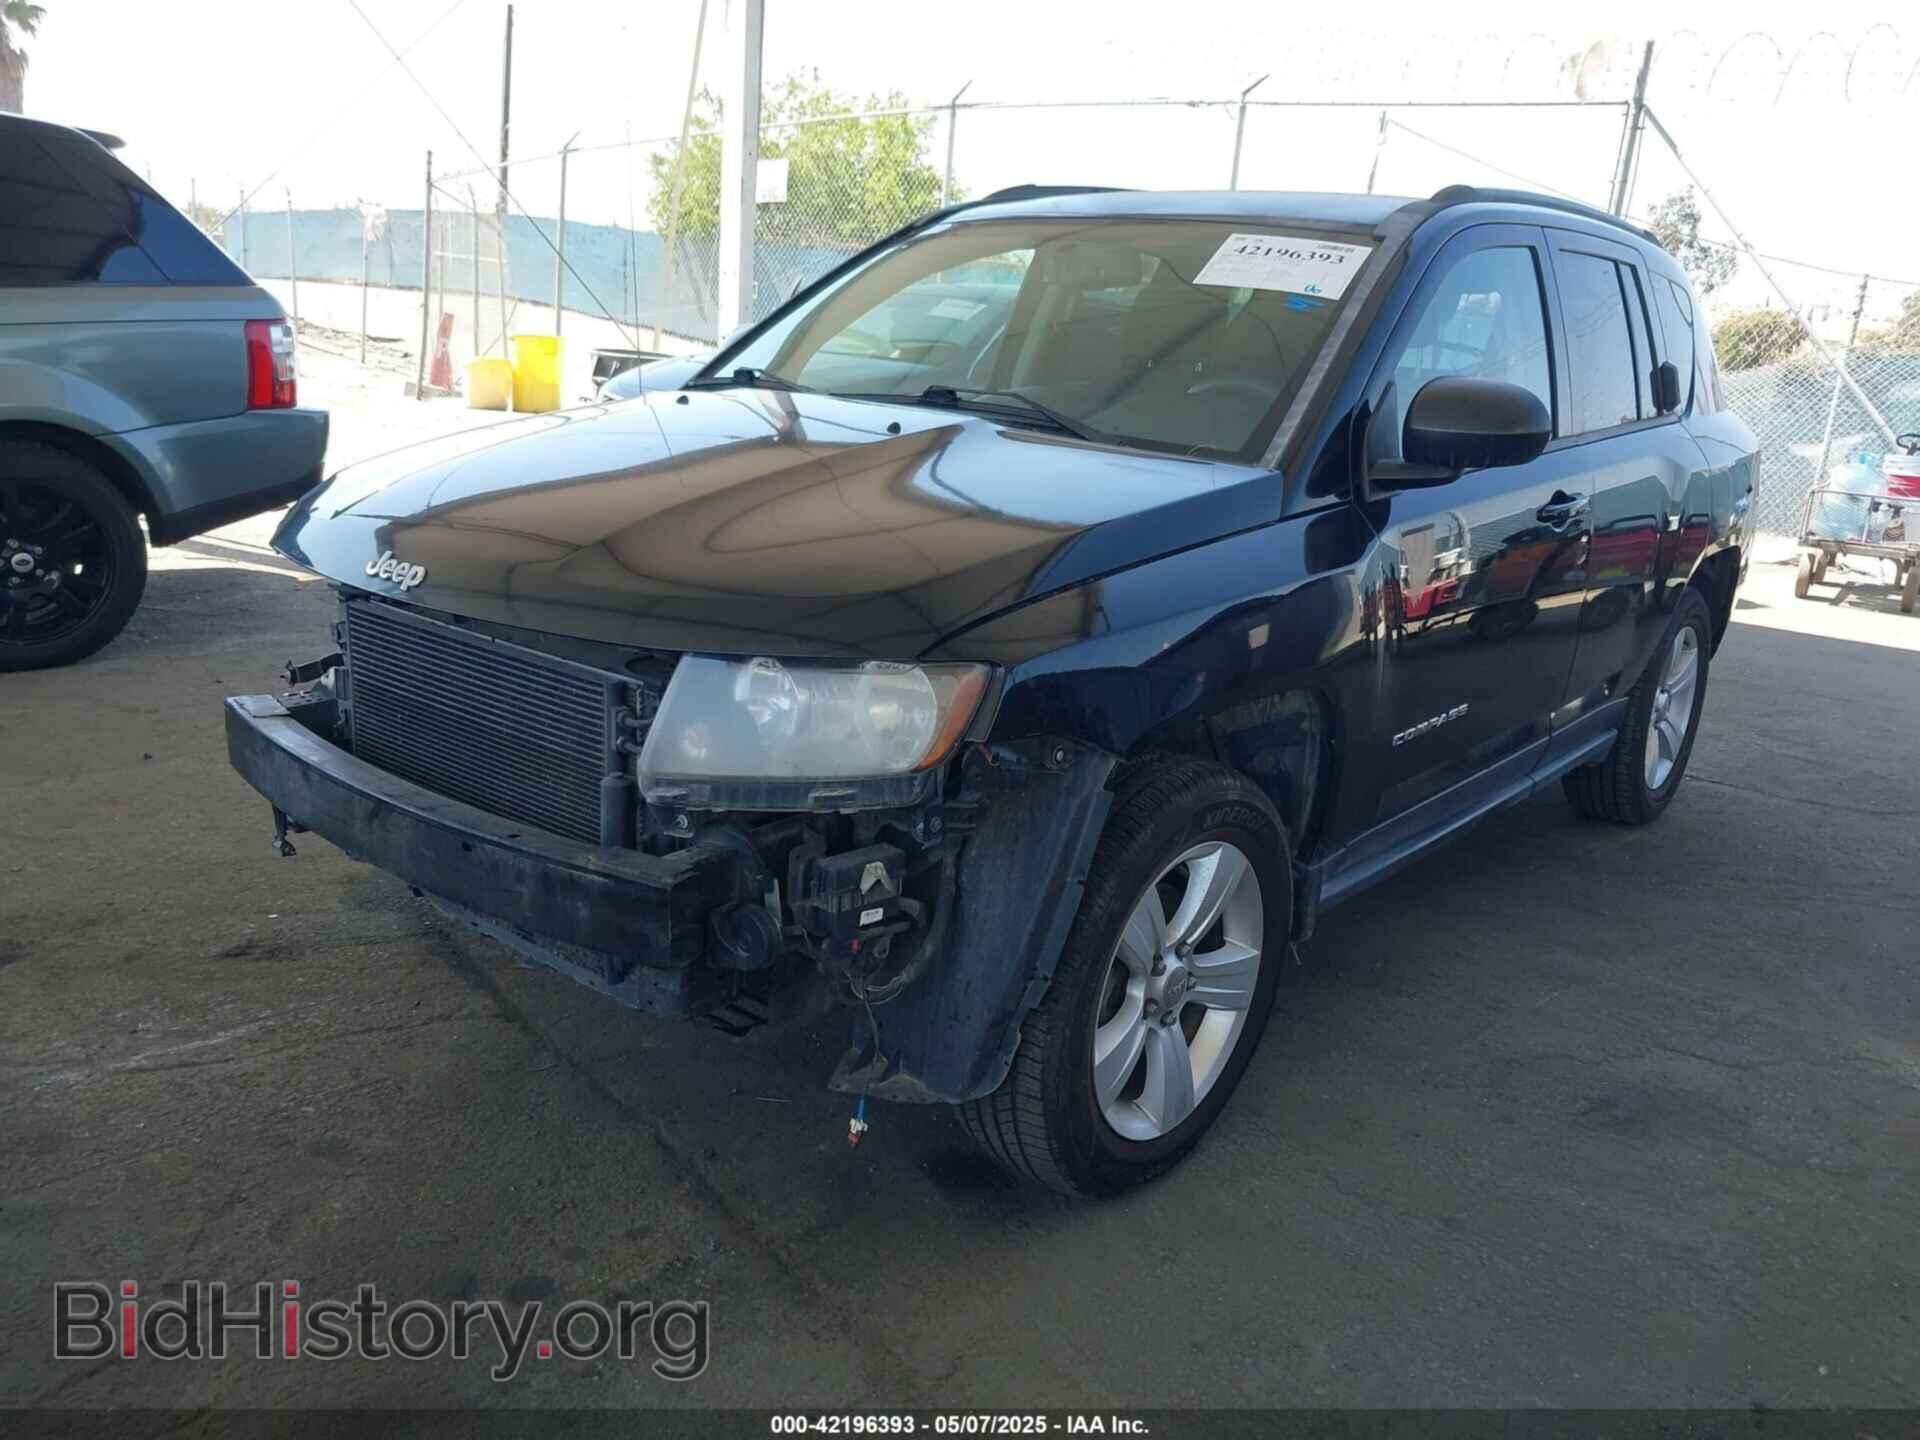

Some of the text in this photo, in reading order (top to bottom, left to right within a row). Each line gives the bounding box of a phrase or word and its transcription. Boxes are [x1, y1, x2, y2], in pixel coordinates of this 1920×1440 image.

[1233, 244, 1346, 264] 42196393
[365, 550, 427, 592] Jeep
[1392, 703, 1469, 746] COMPASS
